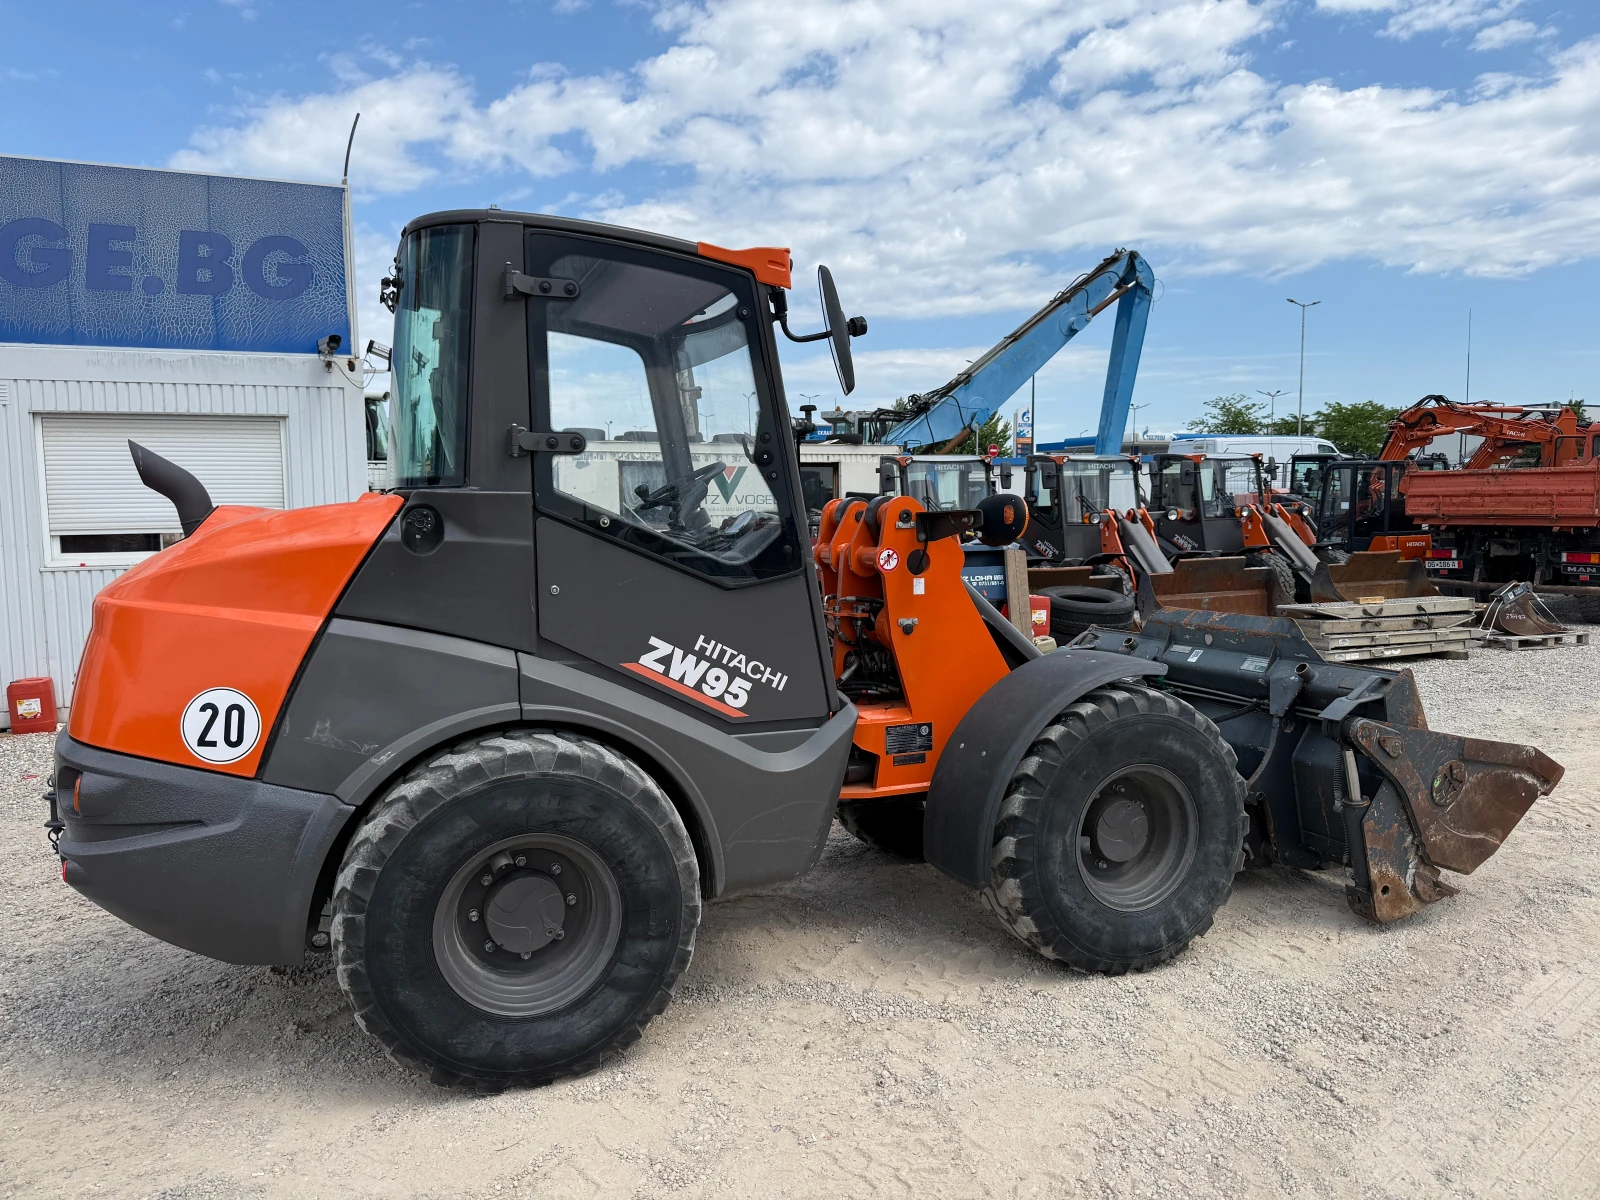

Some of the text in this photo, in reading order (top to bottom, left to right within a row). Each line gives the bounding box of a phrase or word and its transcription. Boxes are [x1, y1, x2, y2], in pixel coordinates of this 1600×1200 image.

[0, 217, 313, 300] GE.BG
[638, 635, 753, 708] ZW95
[693, 634, 789, 692] HITACHI
[197, 702, 245, 748] 20
